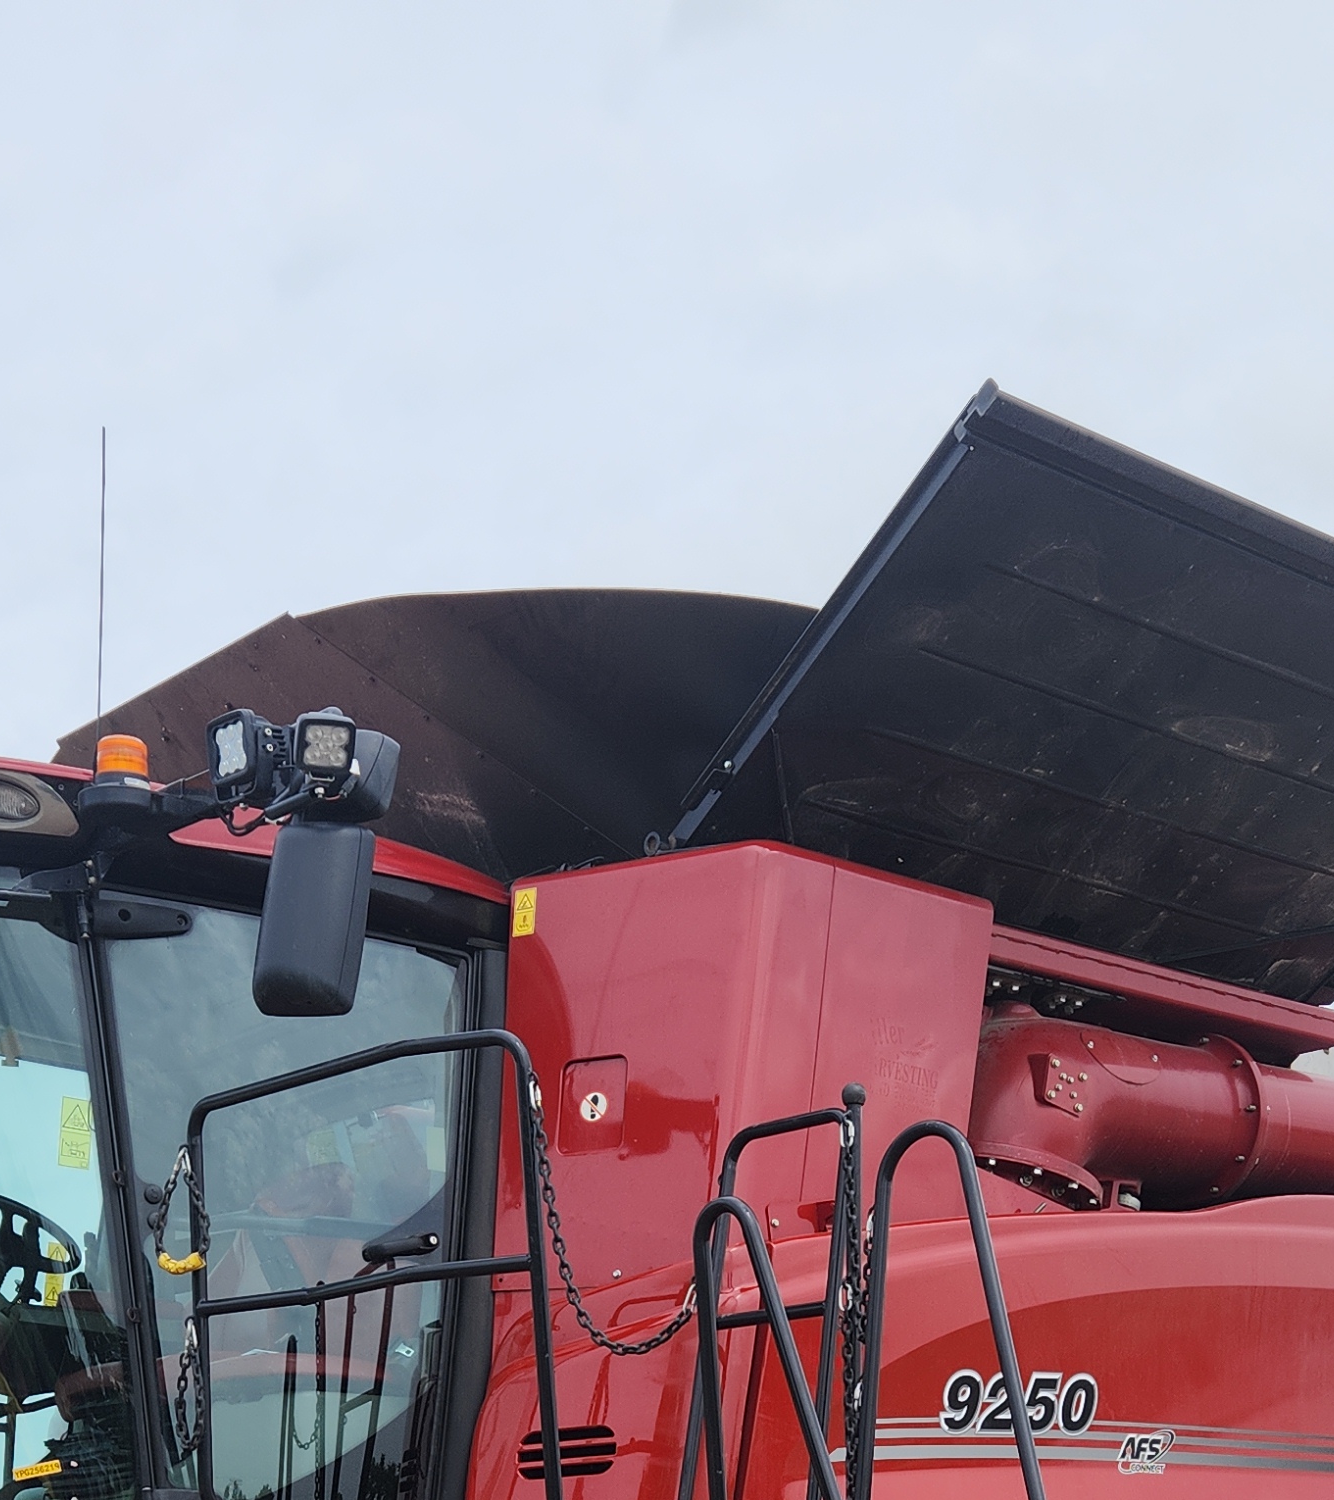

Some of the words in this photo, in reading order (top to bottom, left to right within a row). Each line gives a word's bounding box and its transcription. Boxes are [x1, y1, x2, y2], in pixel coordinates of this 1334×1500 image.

[940, 1370, 1098, 1436] 9250
[1117, 1434, 1164, 1462] AFS
[14, 1462, 60, 1478] YPG256219
[1130, 1462, 1165, 1475] CONNECT
